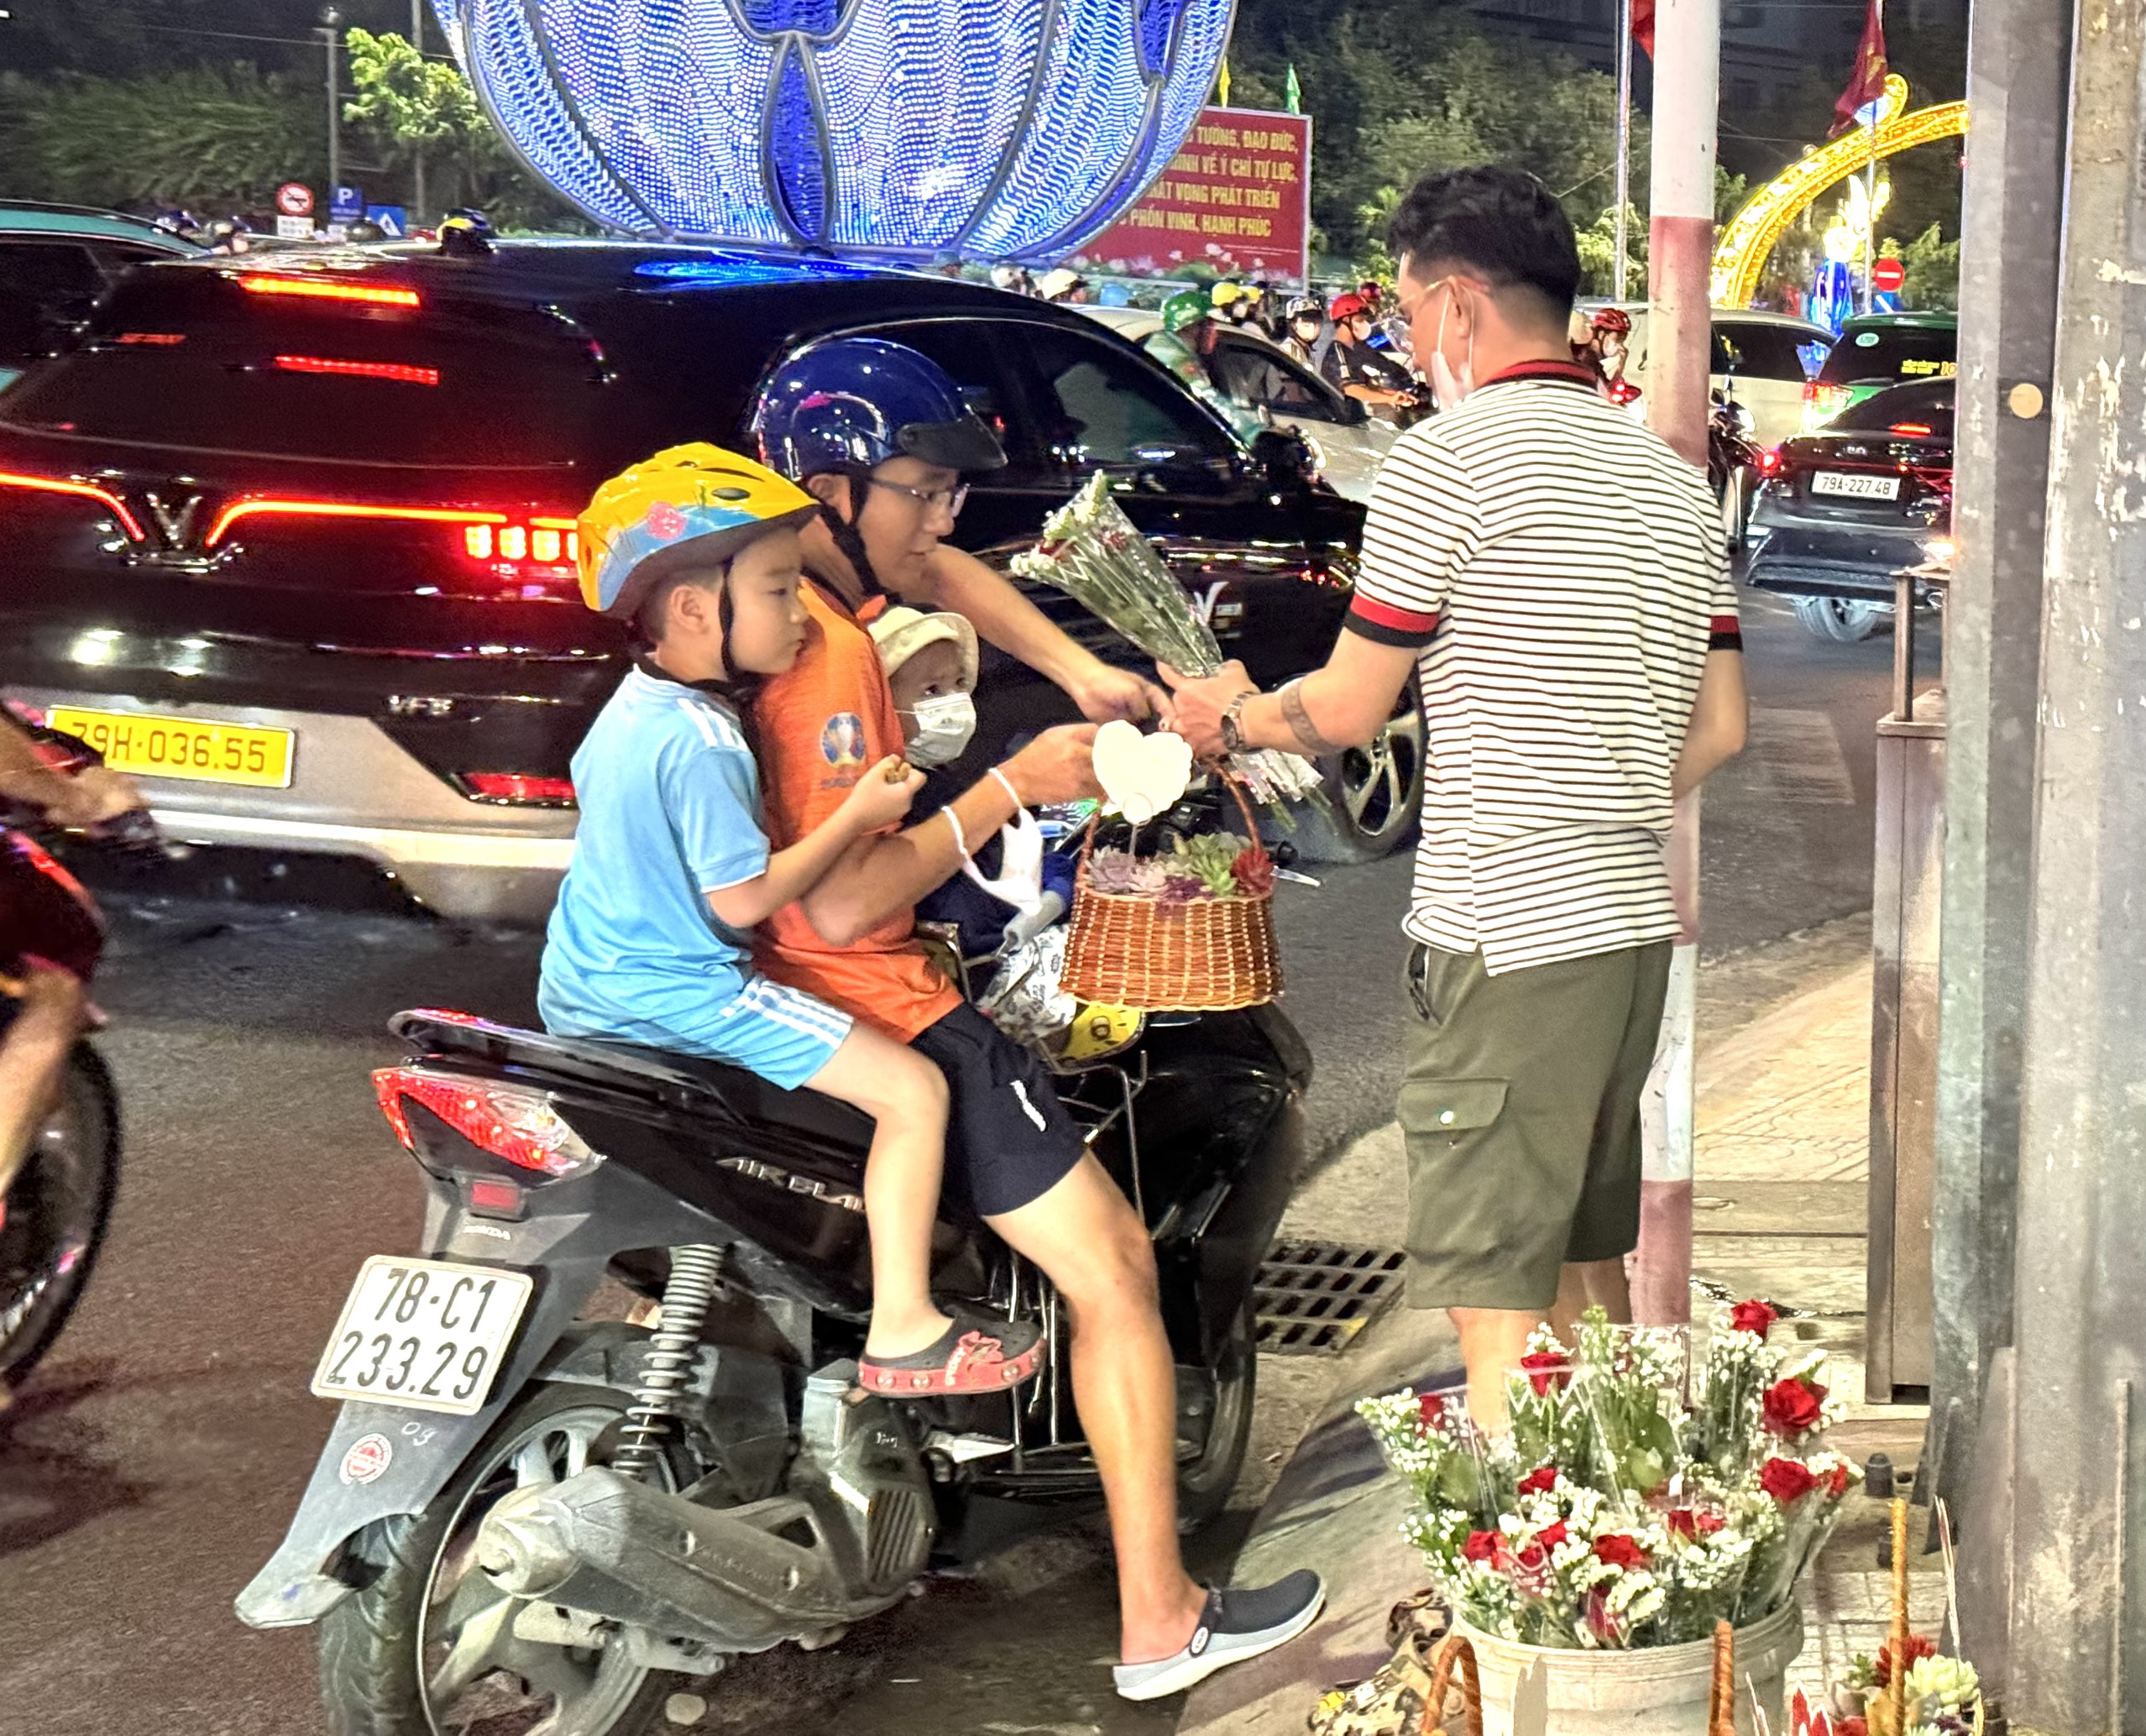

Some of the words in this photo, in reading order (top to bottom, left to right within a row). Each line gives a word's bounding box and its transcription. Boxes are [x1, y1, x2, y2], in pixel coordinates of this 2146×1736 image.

[338, 187, 353, 205] P
[1146, 175, 1172, 199] HÁT
[1821, 476, 1892, 495] 79A-227.48
[326, 1331, 489, 1400] 233.29
